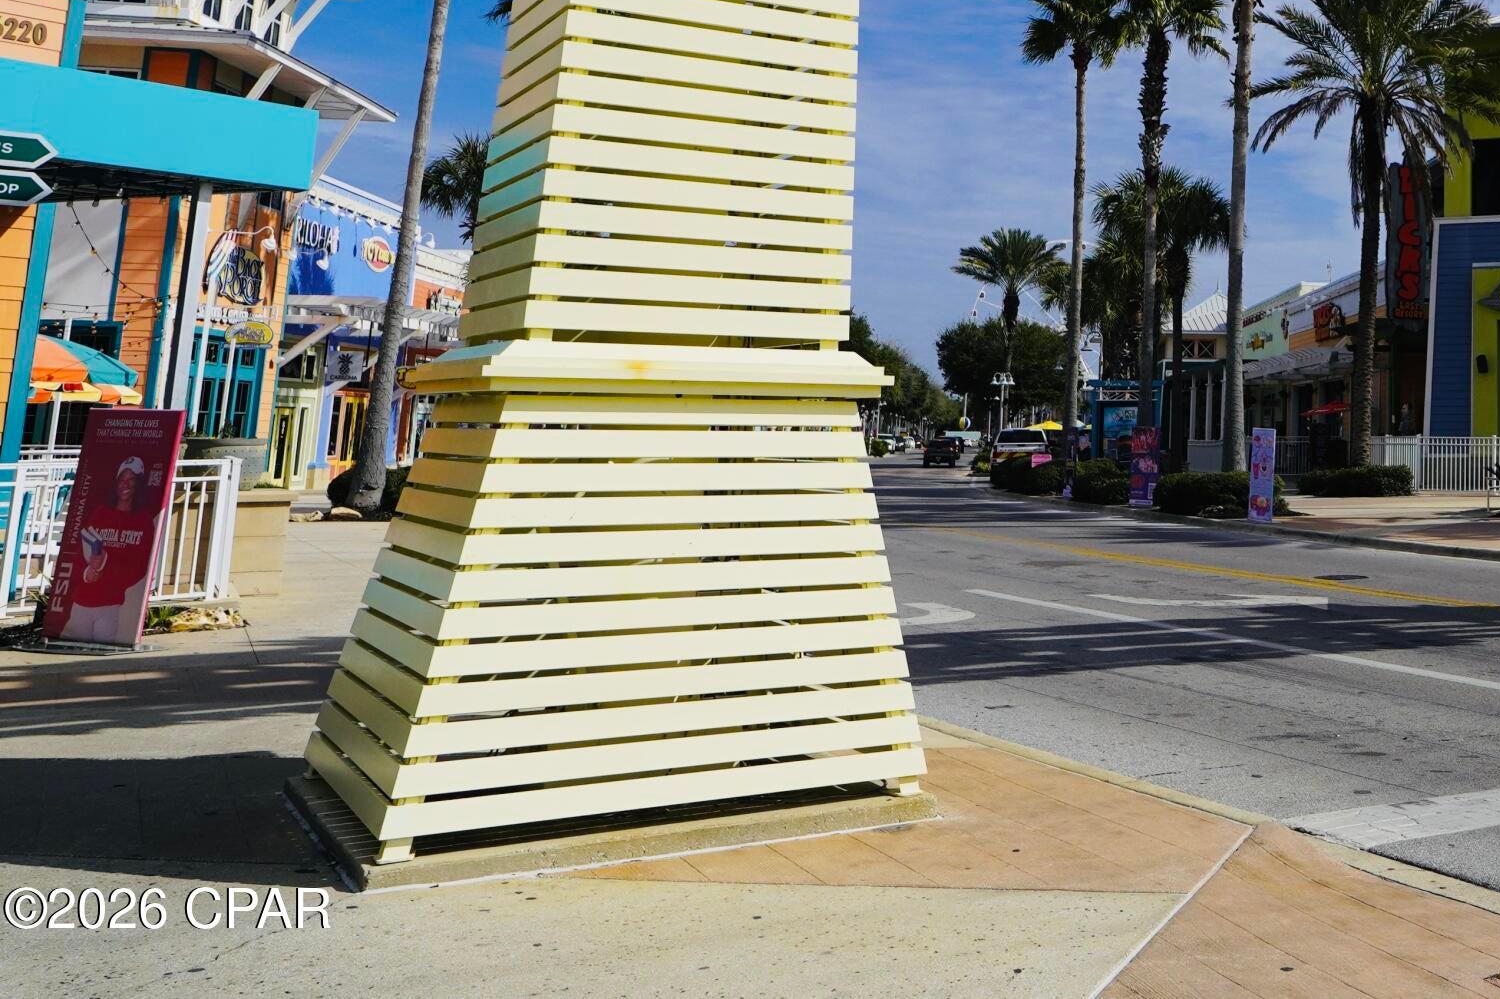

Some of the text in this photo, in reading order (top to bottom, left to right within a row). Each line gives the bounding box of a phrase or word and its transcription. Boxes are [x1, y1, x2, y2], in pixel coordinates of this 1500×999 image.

[105, 419, 133, 428] CHANGING
[144, 420, 160, 428] LIVES
[51, 474, 93, 613] FSU PANAMA CITY
[119, 529, 144, 545] STATE
